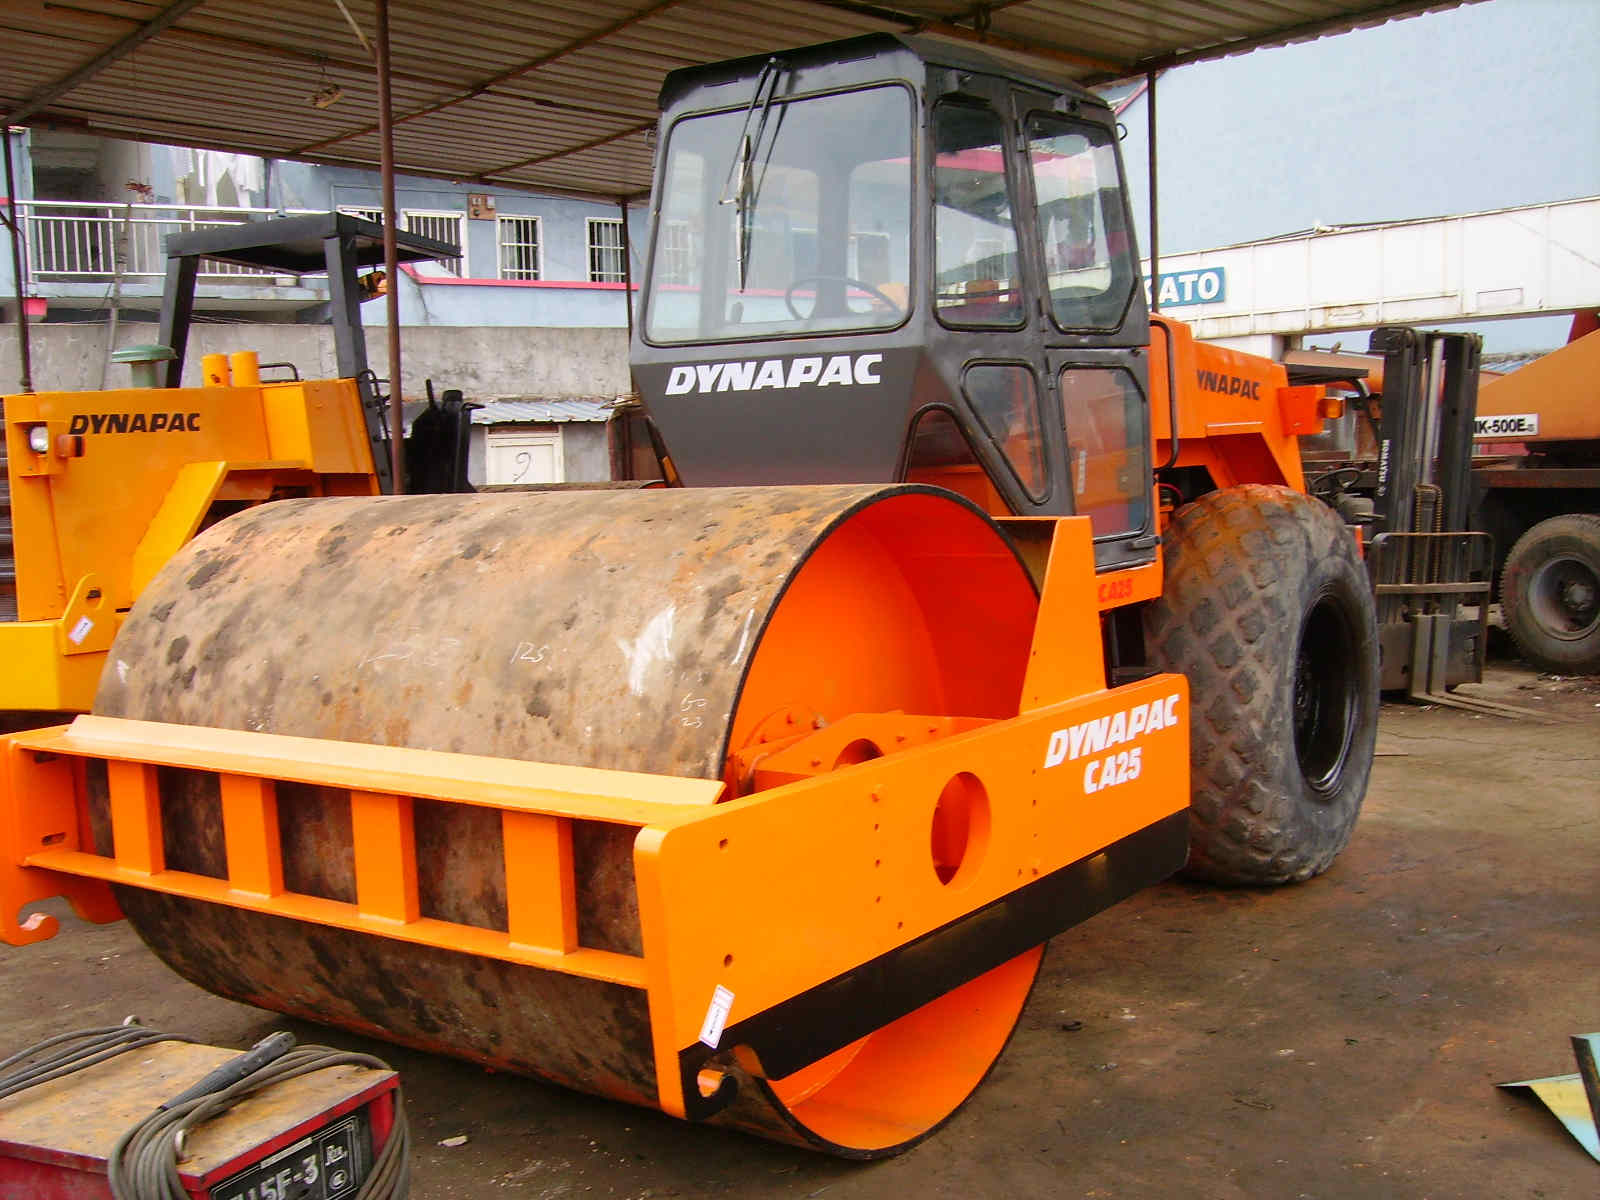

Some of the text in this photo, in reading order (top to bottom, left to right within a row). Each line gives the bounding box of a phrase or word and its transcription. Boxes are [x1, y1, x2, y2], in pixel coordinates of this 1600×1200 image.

[665, 353, 883, 395] DYNAPAC
[69, 412, 201, 435] DYNAPAC
[1098, 579, 1133, 603] CA25
[1044, 694, 1180, 768] DYNAPAC
[1083, 747, 1143, 795] CA25
